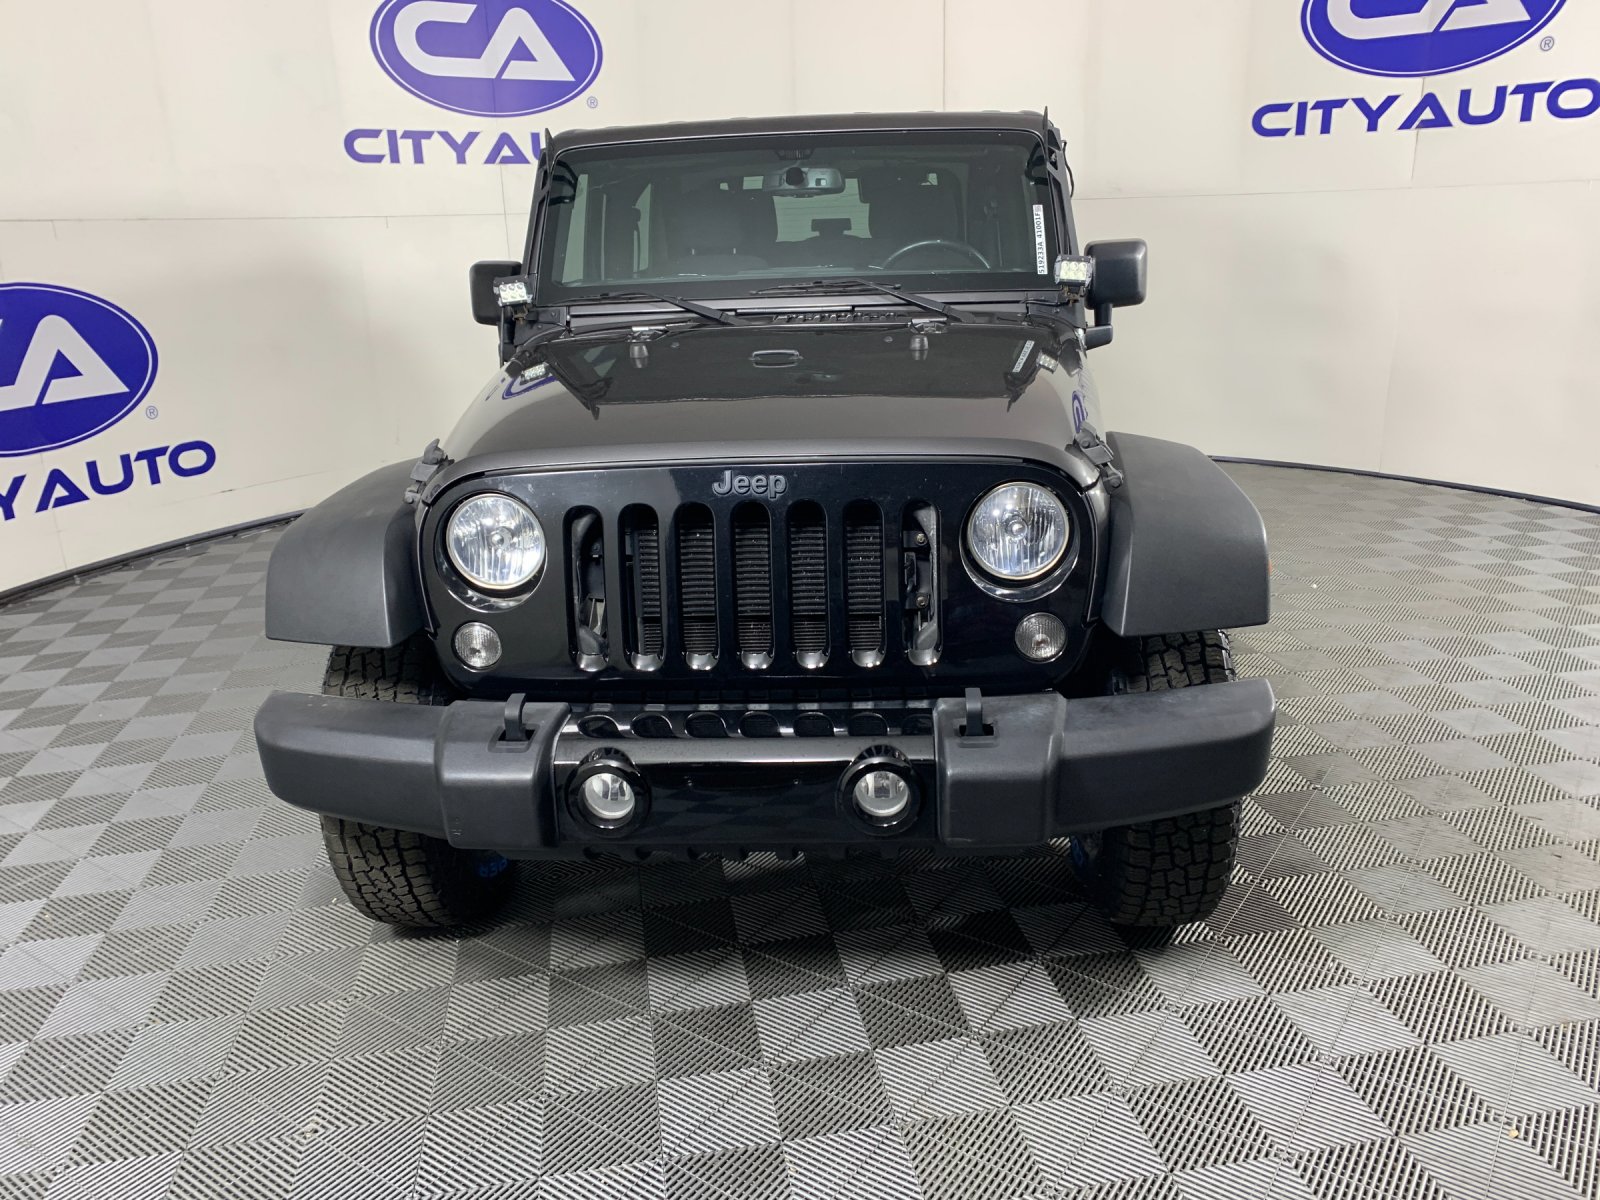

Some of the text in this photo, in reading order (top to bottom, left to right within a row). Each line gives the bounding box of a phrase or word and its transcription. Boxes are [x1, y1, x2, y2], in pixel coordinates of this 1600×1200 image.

[393, 0, 577, 82] CA
[0, 314, 131, 412] A
[711, 469, 788, 500] Jeep
